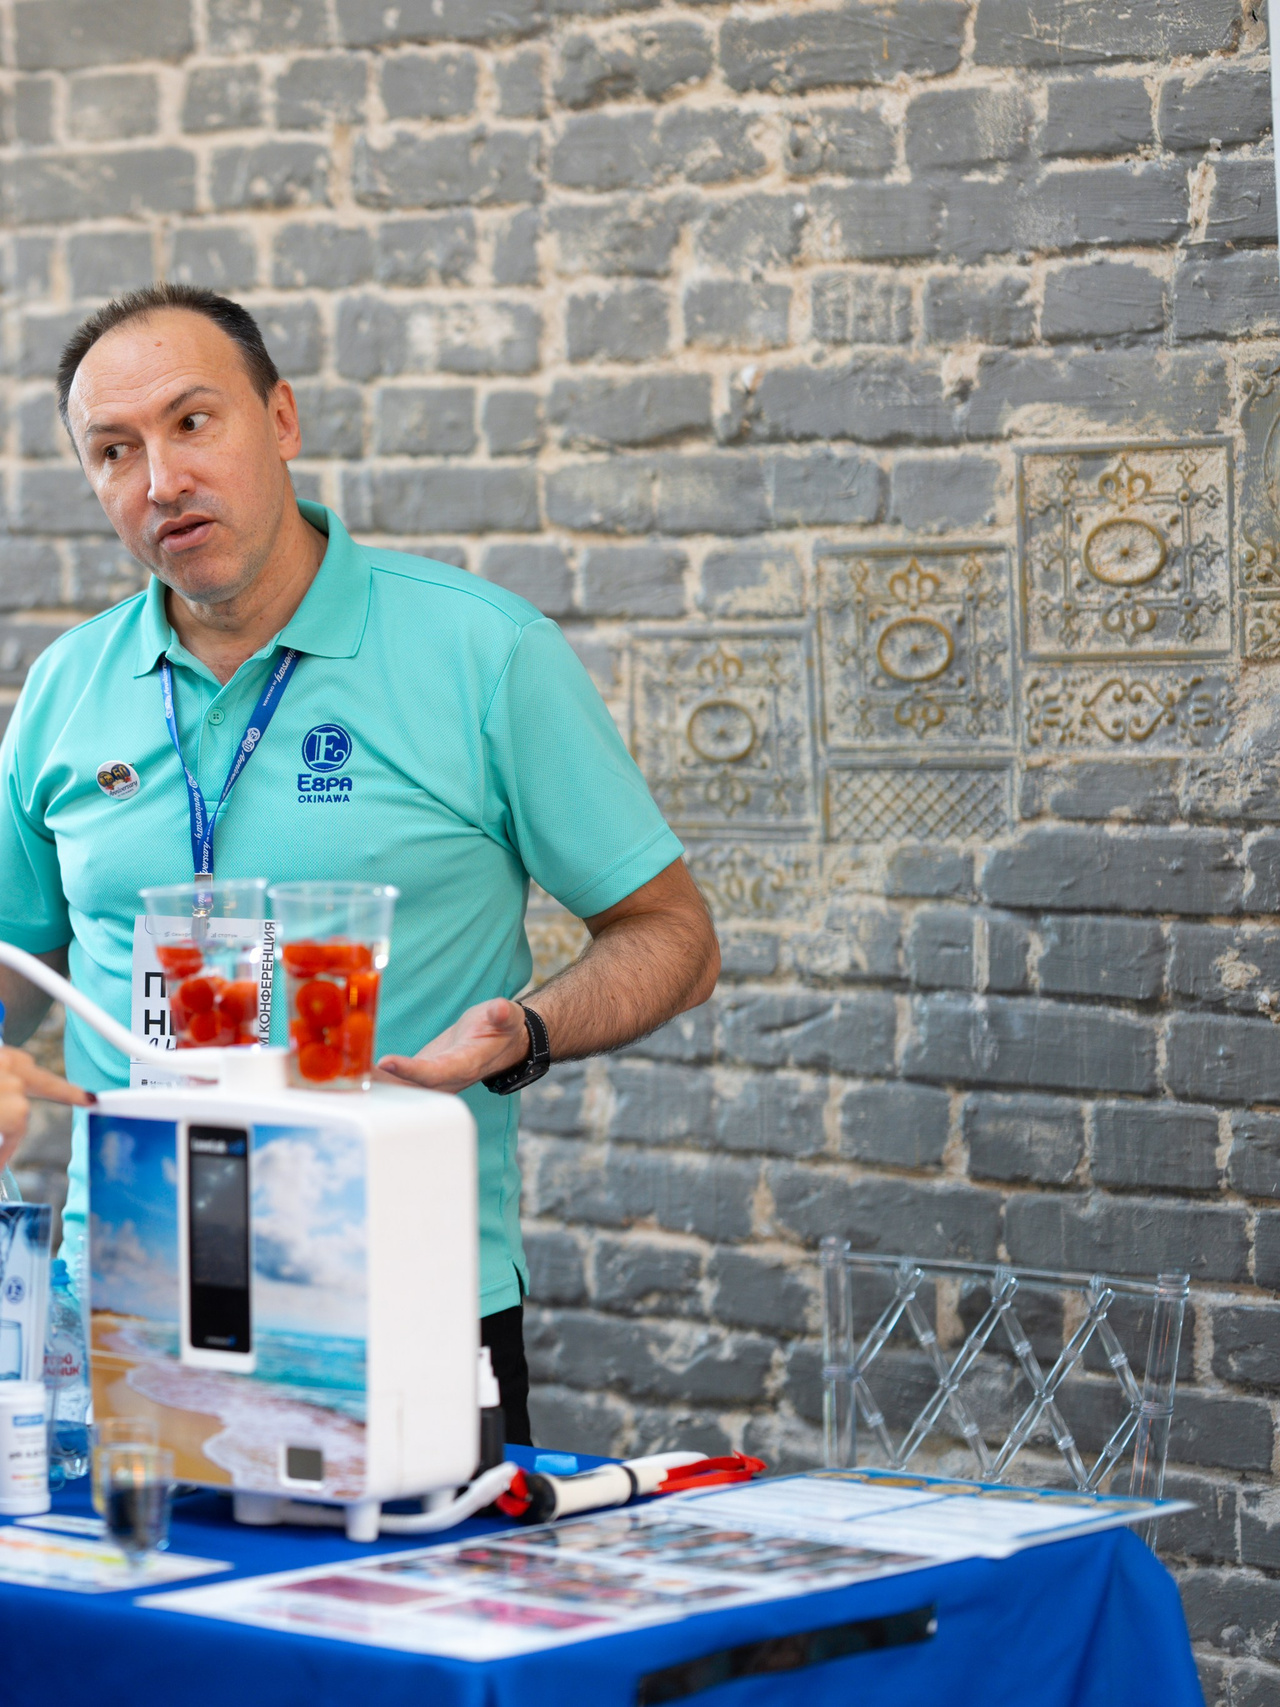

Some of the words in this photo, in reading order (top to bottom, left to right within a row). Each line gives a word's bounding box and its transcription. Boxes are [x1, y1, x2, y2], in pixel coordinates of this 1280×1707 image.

[191, 788, 205, 840] Anniversary
[298, 794, 351, 803] OKINAWA
[259, 921, 276, 1034] КОНФЕРЕНЦИЯ
